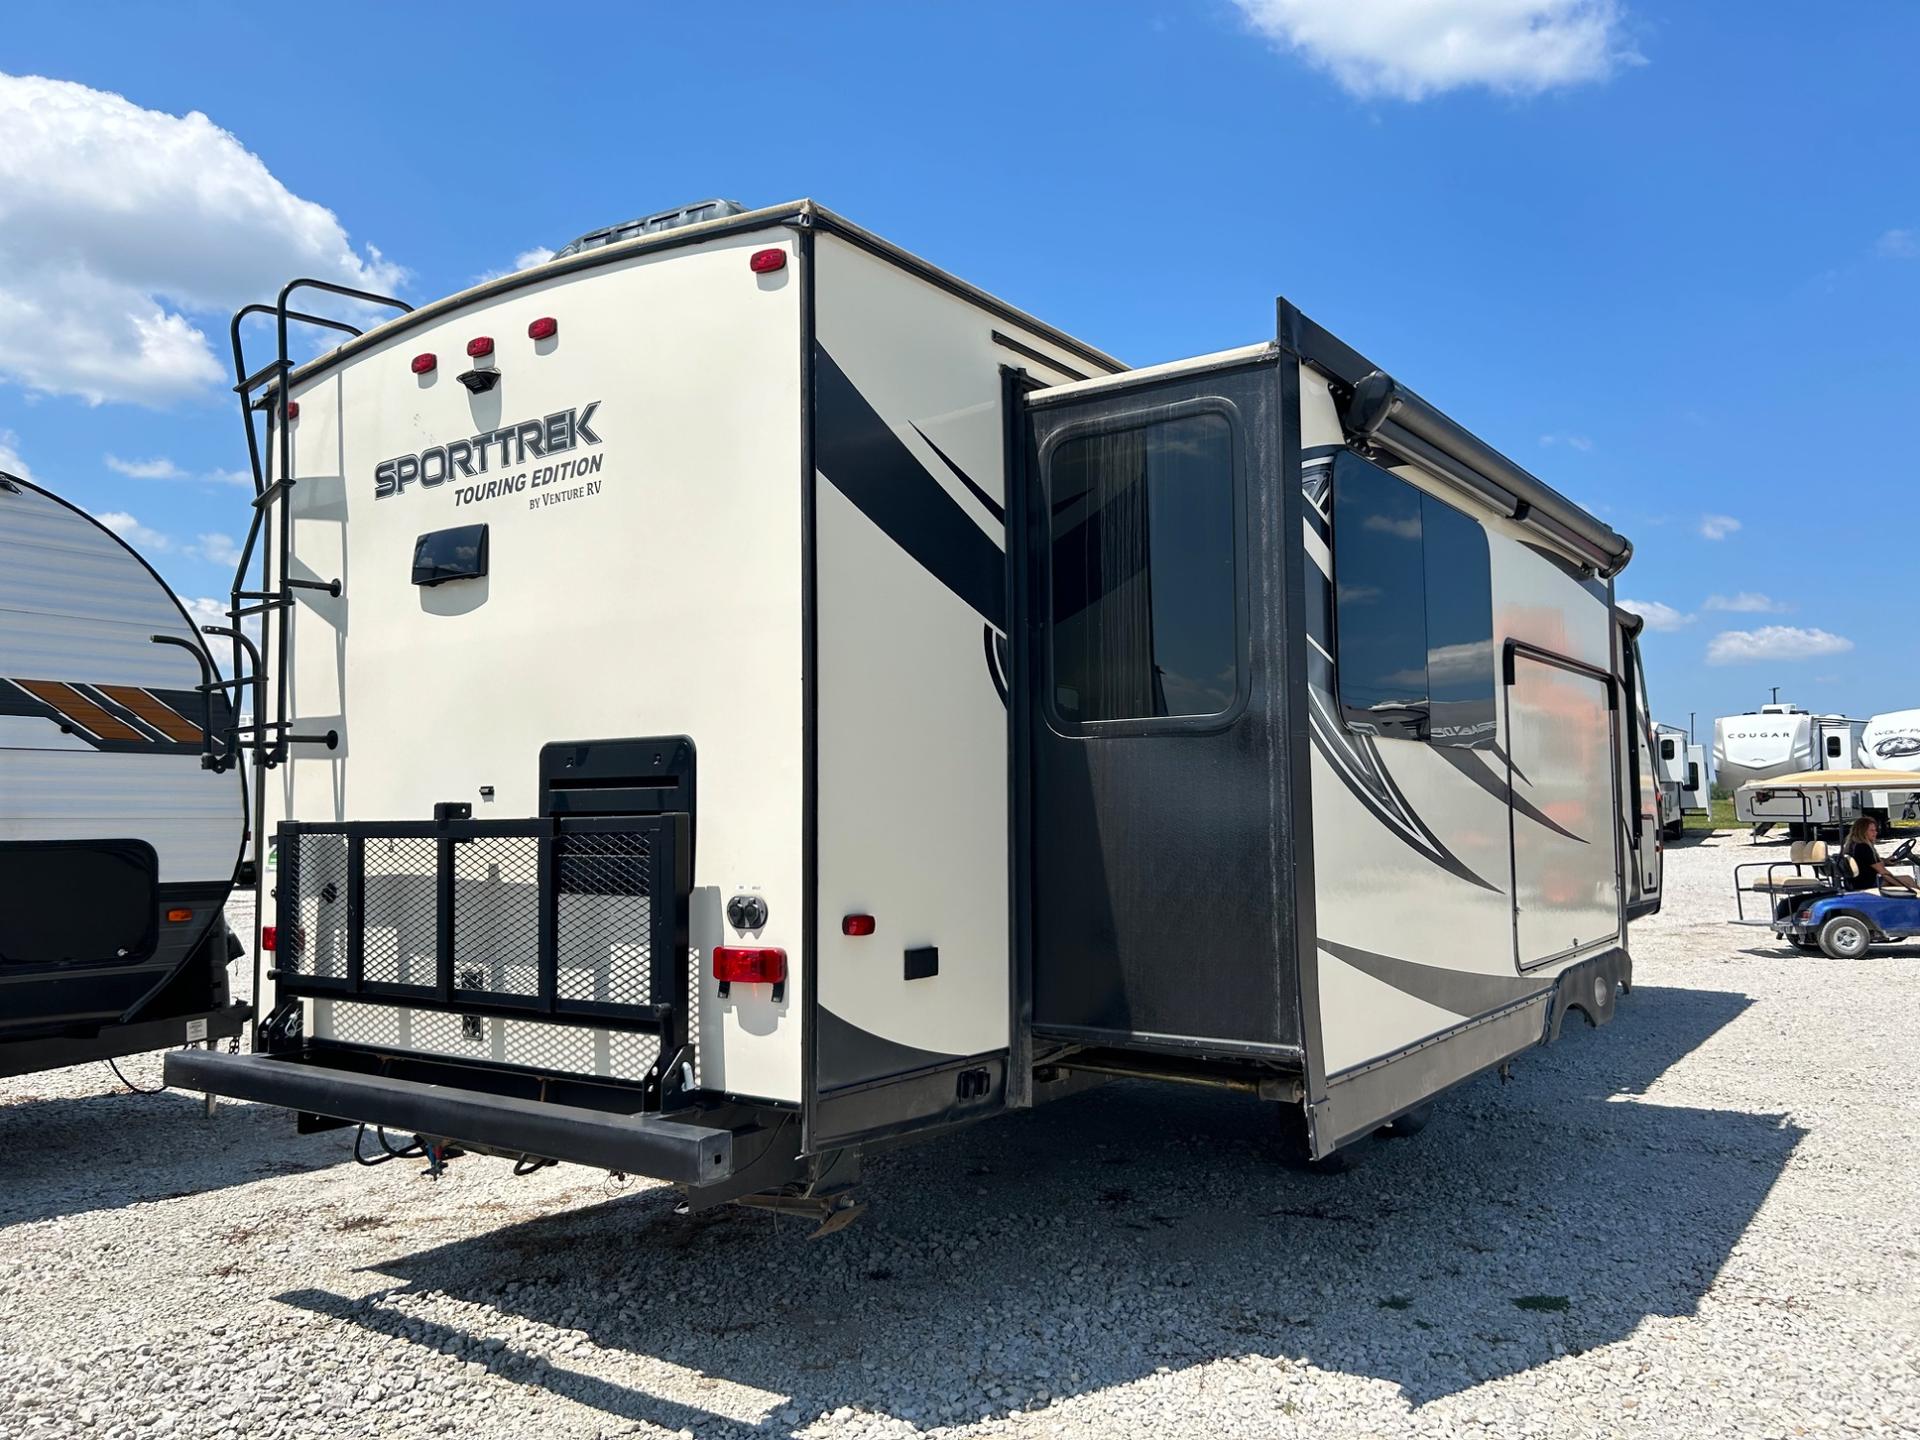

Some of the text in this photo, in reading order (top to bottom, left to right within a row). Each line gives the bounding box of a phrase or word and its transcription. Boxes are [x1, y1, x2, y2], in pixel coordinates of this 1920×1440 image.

[374, 400, 603, 500] SPORTTREK
[454, 453, 604, 507] TOURING EDITION
[529, 480, 602, 510] BY VENTURE RV
